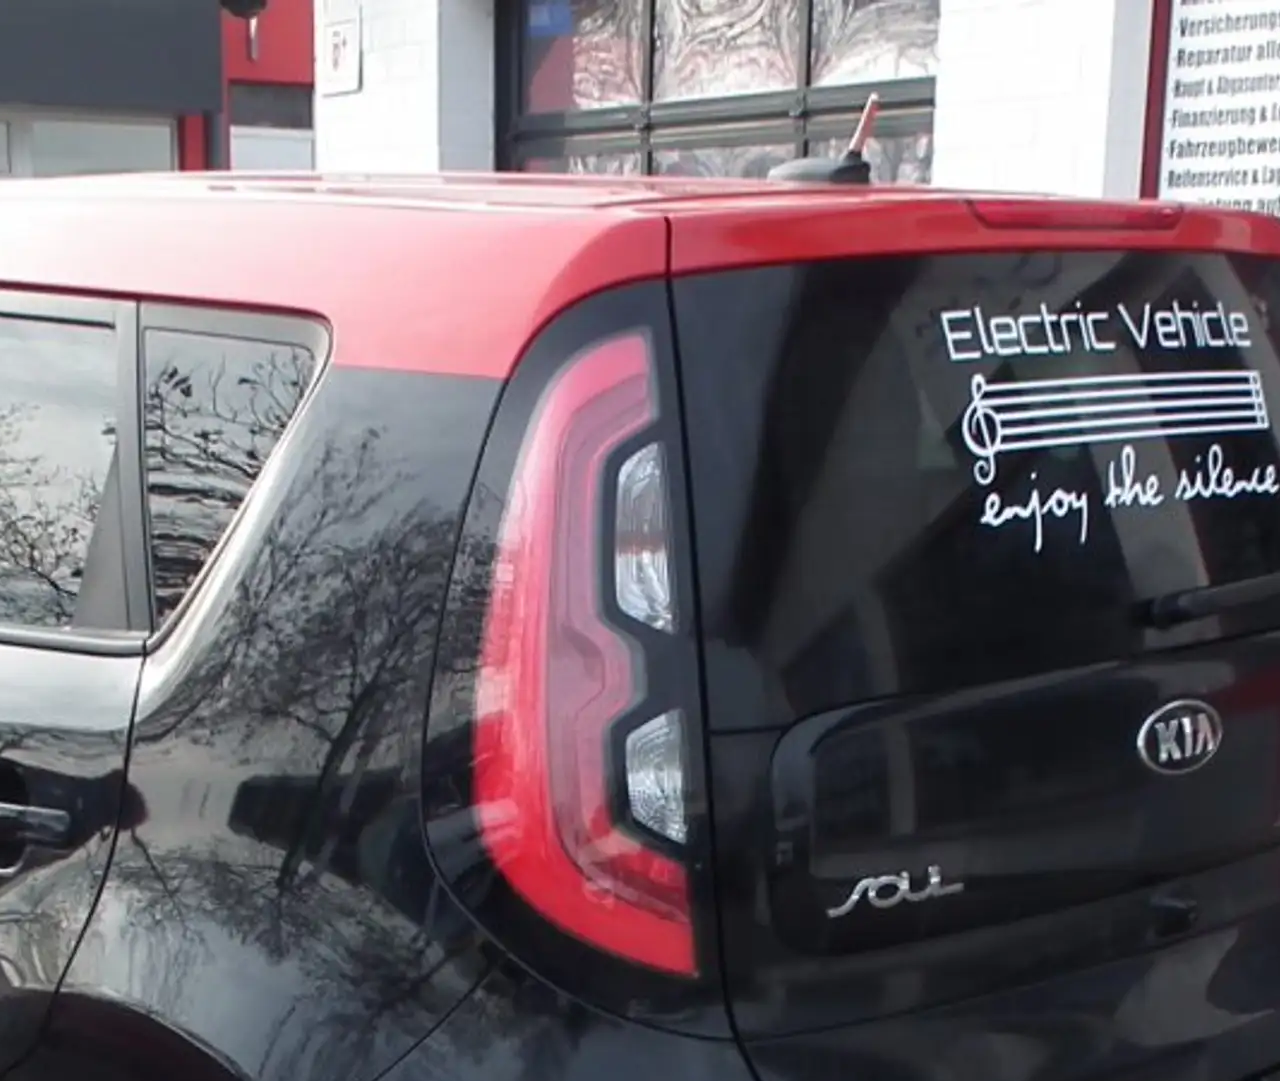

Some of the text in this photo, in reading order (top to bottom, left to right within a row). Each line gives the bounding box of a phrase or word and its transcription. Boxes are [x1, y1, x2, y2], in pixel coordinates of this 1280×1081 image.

[1176, 43, 1252, 69] Reparatur
[1171, 105, 1256, 129] Finanzierung
[1167, 167, 1248, 189] Reifenservice
[941, 299, 1252, 361] Electric Vehicle
[980, 444, 1280, 553] enjoy the silence
[1154, 712, 1216, 762] KIA
